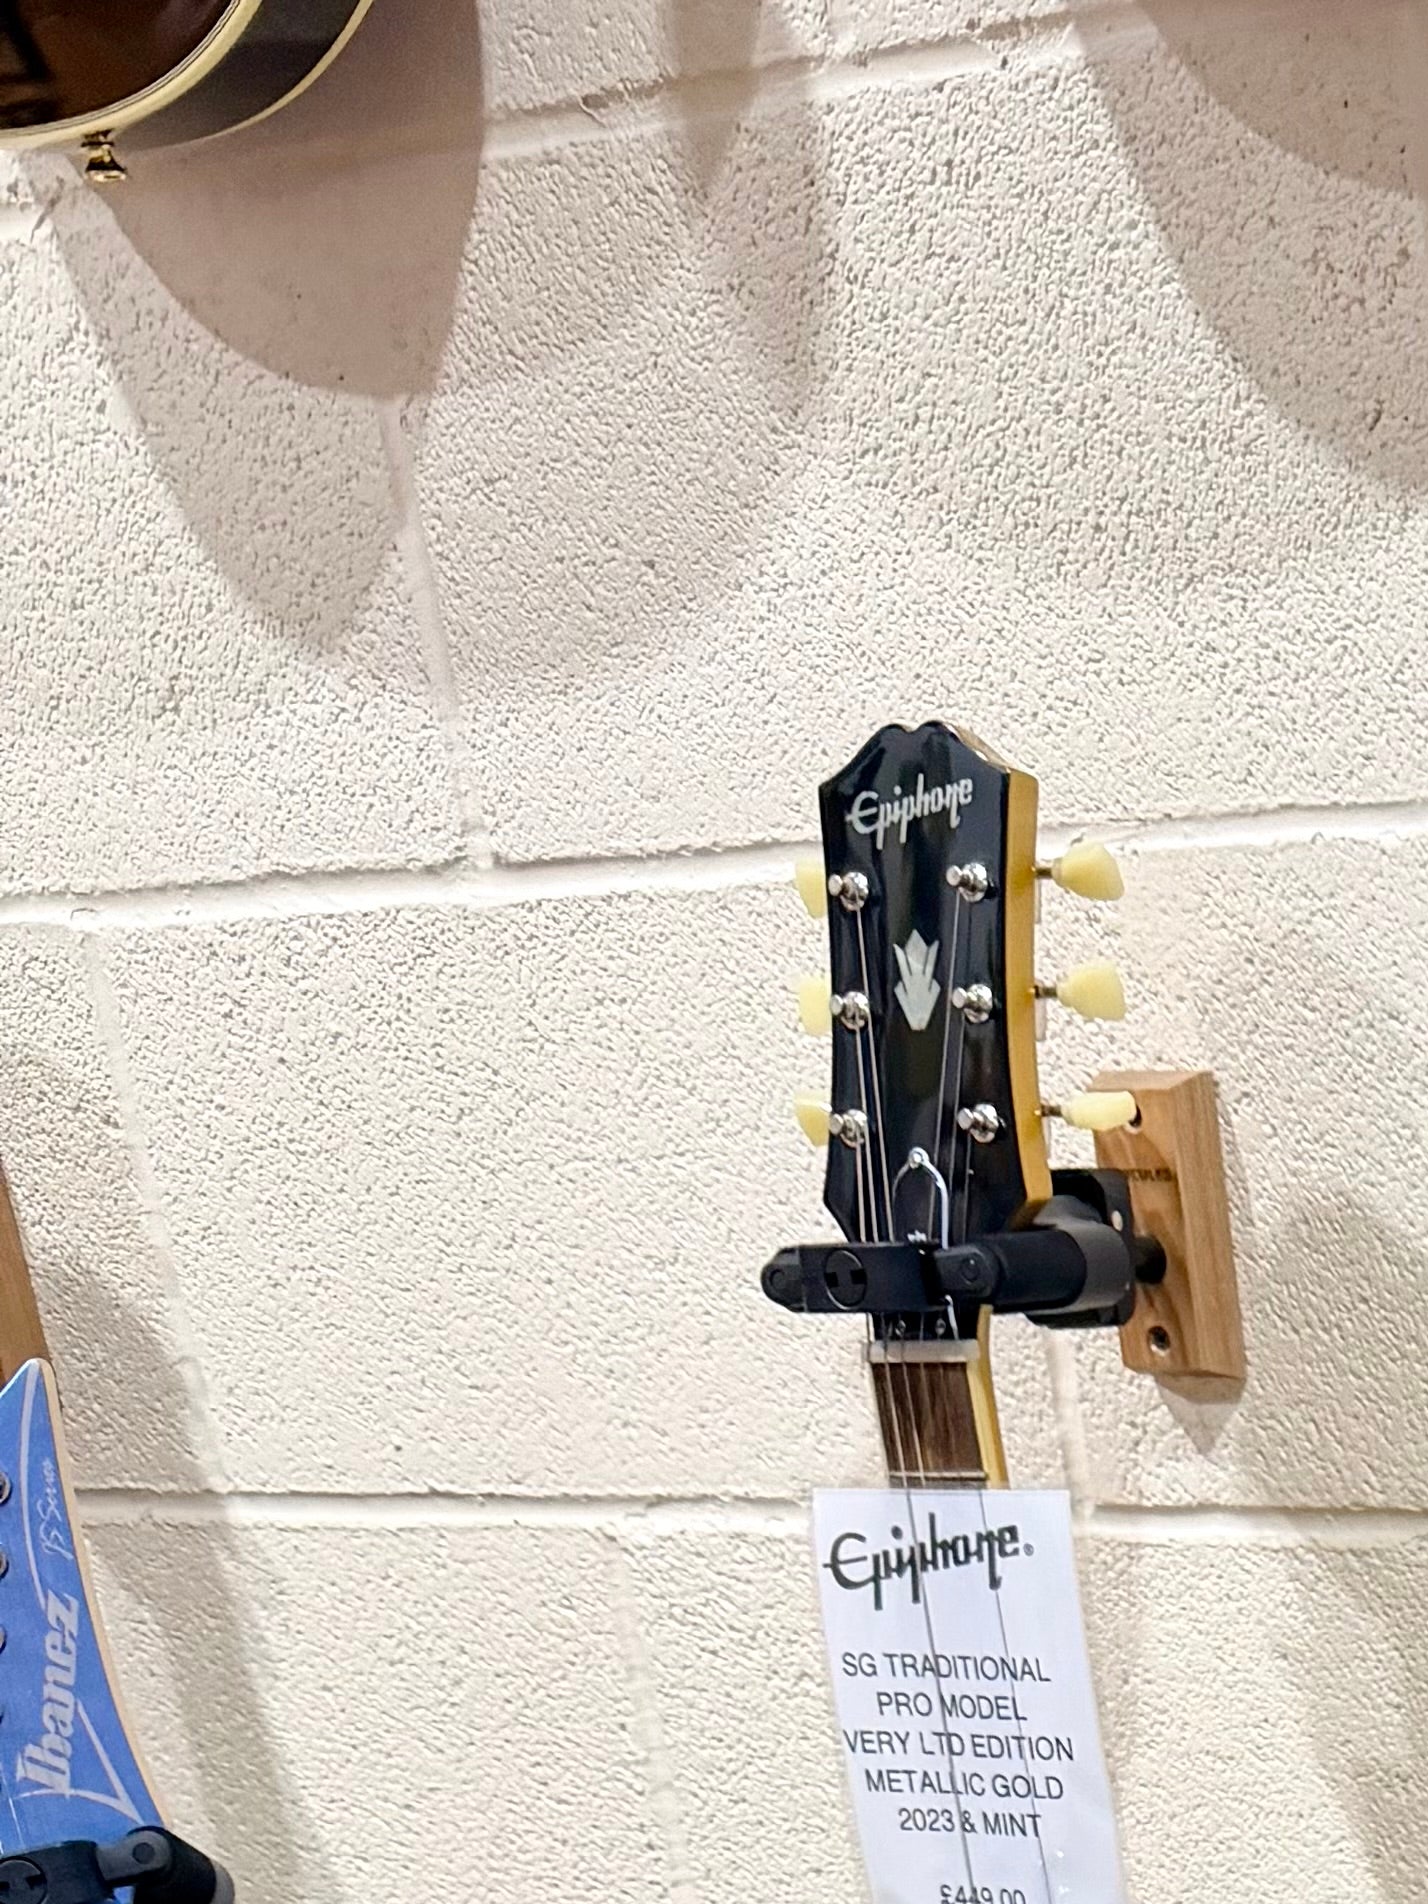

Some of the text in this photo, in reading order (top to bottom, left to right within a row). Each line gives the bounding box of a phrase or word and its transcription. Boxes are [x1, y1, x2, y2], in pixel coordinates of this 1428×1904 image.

[845, 773, 973, 850] Epiphone
[822, 1513, 1020, 1611] Epiphone
[842, 1653, 1051, 1682] SG TRADITIONAL
[16, 1588, 79, 1798] Ibanez
[876, 1693, 1028, 1721] PRO MODEL
[842, 1731, 1074, 1761] VERY LTD EDITION
[864, 1769, 1064, 1800] METALLIC GOLD
[899, 1808, 1042, 1838] 2023 & MINT
